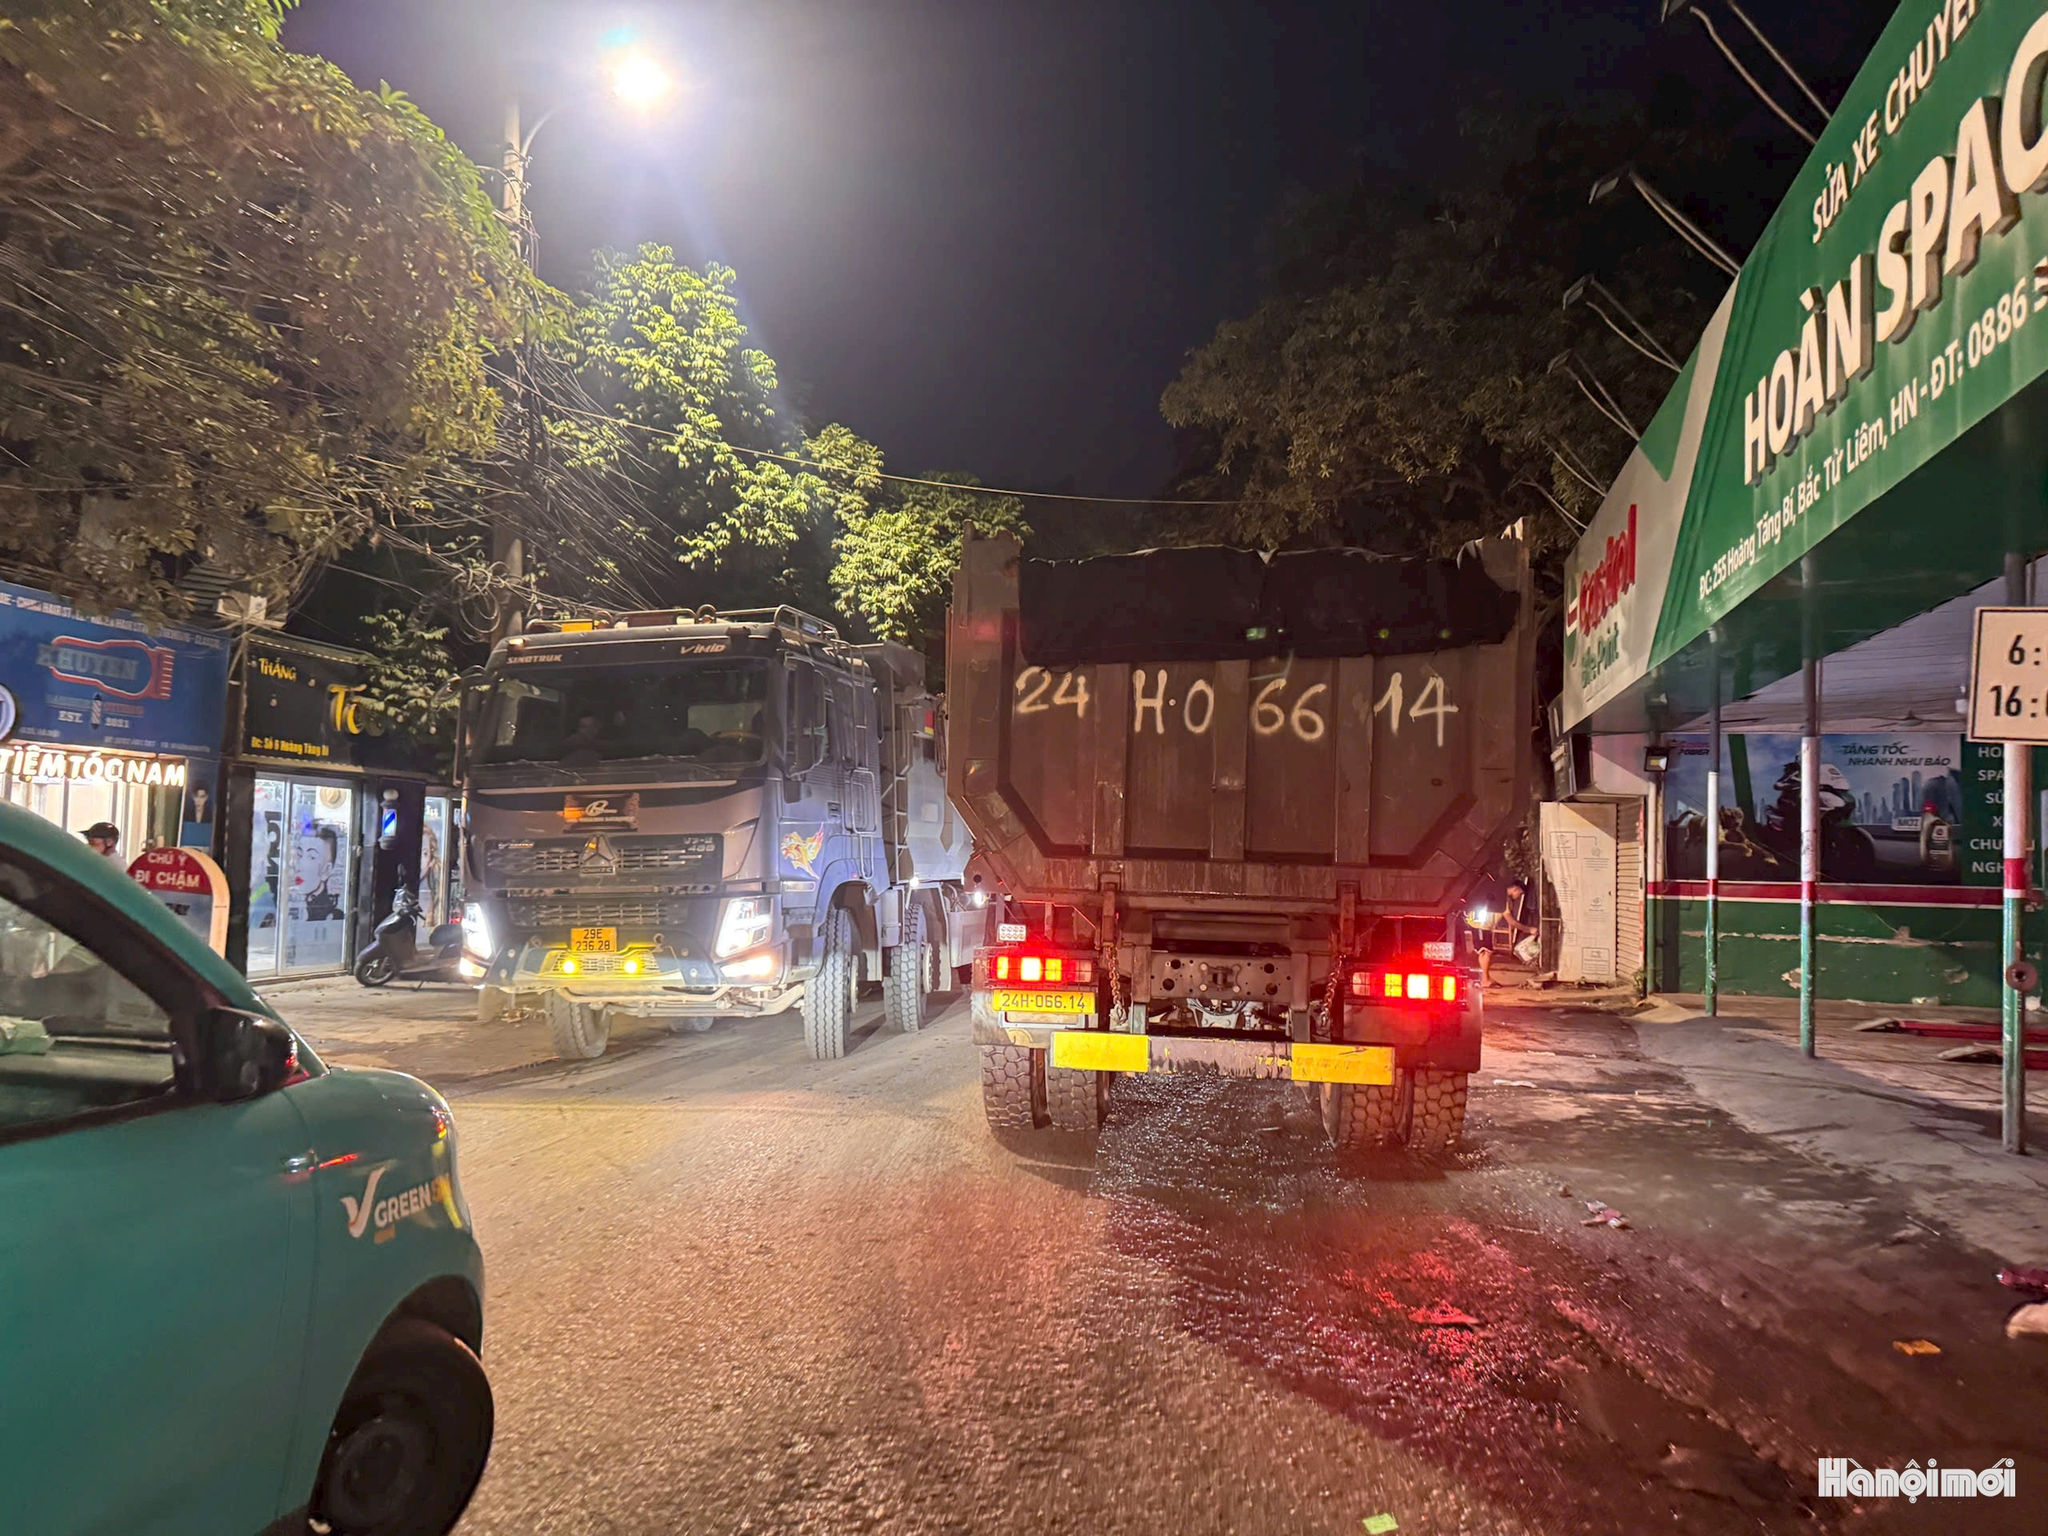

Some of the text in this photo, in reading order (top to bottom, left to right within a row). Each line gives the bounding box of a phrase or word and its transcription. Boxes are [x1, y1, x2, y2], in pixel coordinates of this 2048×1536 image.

[1812, 162, 1848, 244] SỬA
[1851, 108, 1878, 190] XE
[1744, 254, 1864, 485] HOÀN
[1712, 555, 1728, 591] 255
[1846, 416, 1888, 473] Liêm,
[1890, 377, 1918, 437] HN
[1930, 338, 1964, 400] ĐT:
[1967, 276, 2028, 369] 0886
[506, 653, 564, 665] SINOTRUK
[1015, 665, 1090, 719] 24
[1252, 678, 1328, 742] 66
[1372, 671, 1460, 748] 14
[69, 751, 124, 783] TÓC
[127, 760, 187, 787] NAM
[134, 869, 200, 890] ĐI CHẬM
[575, 940, 611, 951] 236.28
[583, 928, 603, 940] 29E
[374, 1183, 432, 1228] GREEN
